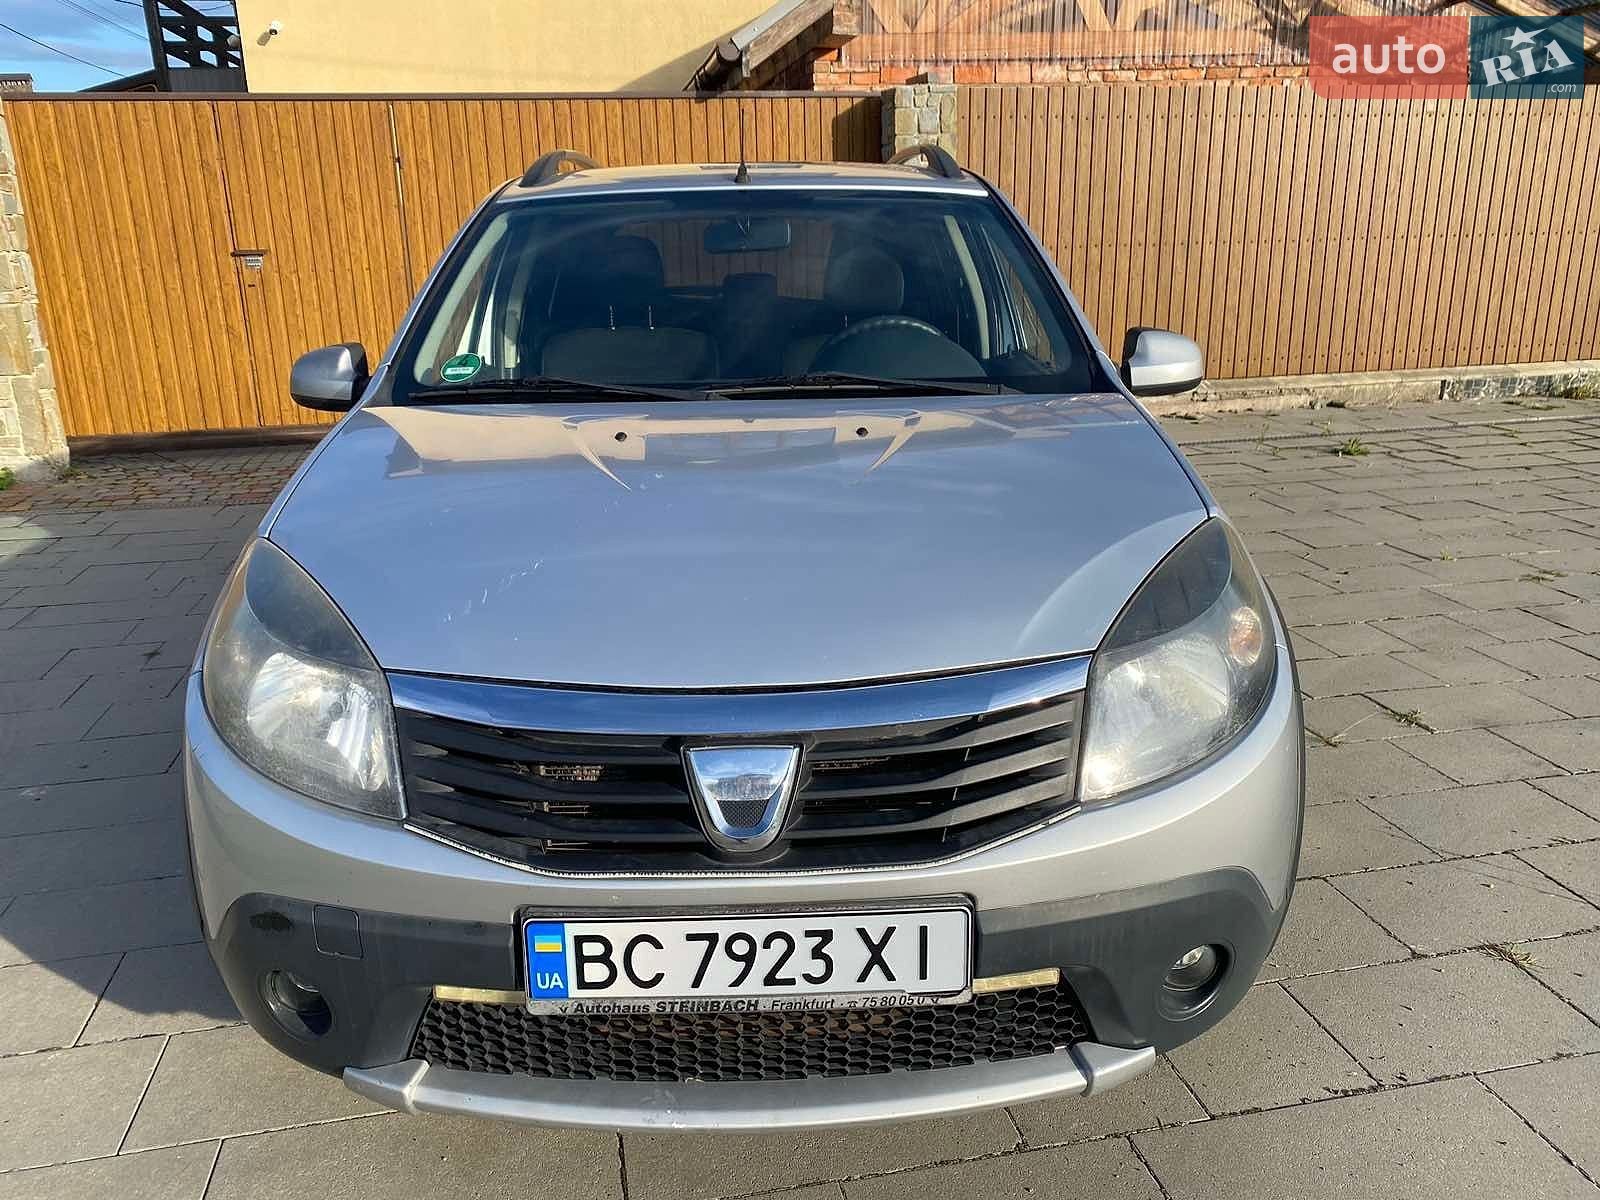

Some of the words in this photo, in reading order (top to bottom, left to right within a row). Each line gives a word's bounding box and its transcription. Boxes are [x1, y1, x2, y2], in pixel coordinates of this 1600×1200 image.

[573, 933, 665, 990] BC
[685, 929, 834, 989] 7923
[536, 972, 564, 989] UA
[574, 1002, 650, 1014] Autohaus
[655, 999, 759, 1013] STEINBACH
[771, 998, 834, 1010] Frankfurt
